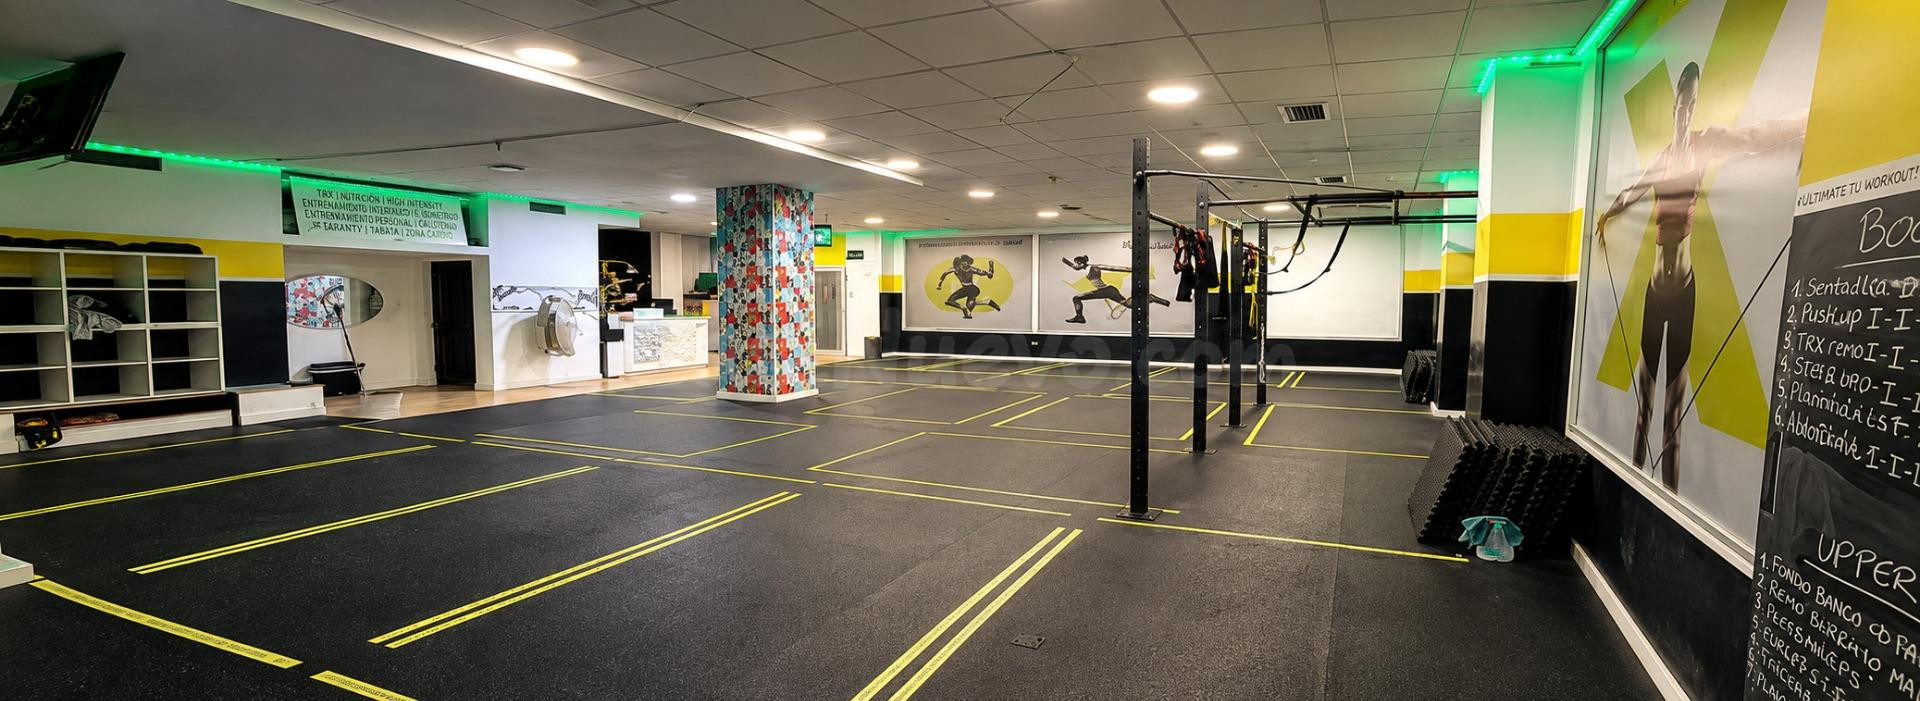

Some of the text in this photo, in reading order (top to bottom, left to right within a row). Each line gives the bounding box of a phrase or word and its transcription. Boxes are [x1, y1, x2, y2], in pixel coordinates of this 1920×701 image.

[1849, 181, 1862, 195] TU
[1865, 165, 1920, 191] WORKOUT!
[316, 188, 334, 199] TRX
[1790, 279, 1802, 298] 1.
[1787, 304, 1798, 323] 2.
[1798, 332, 1826, 354] TRX
[1828, 340, 1864, 359] remo
[1777, 379, 1788, 399] 5.
[1775, 405, 1785, 427] 6.
[1818, 533, 1918, 604] UPPER
[1757, 573, 1766, 590] 2.
[1769, 580, 1804, 615] REMO
[1760, 552, 1769, 570] 1.
[1772, 555, 1811, 594] FONDO
[1815, 586, 1862, 628] BANCO
